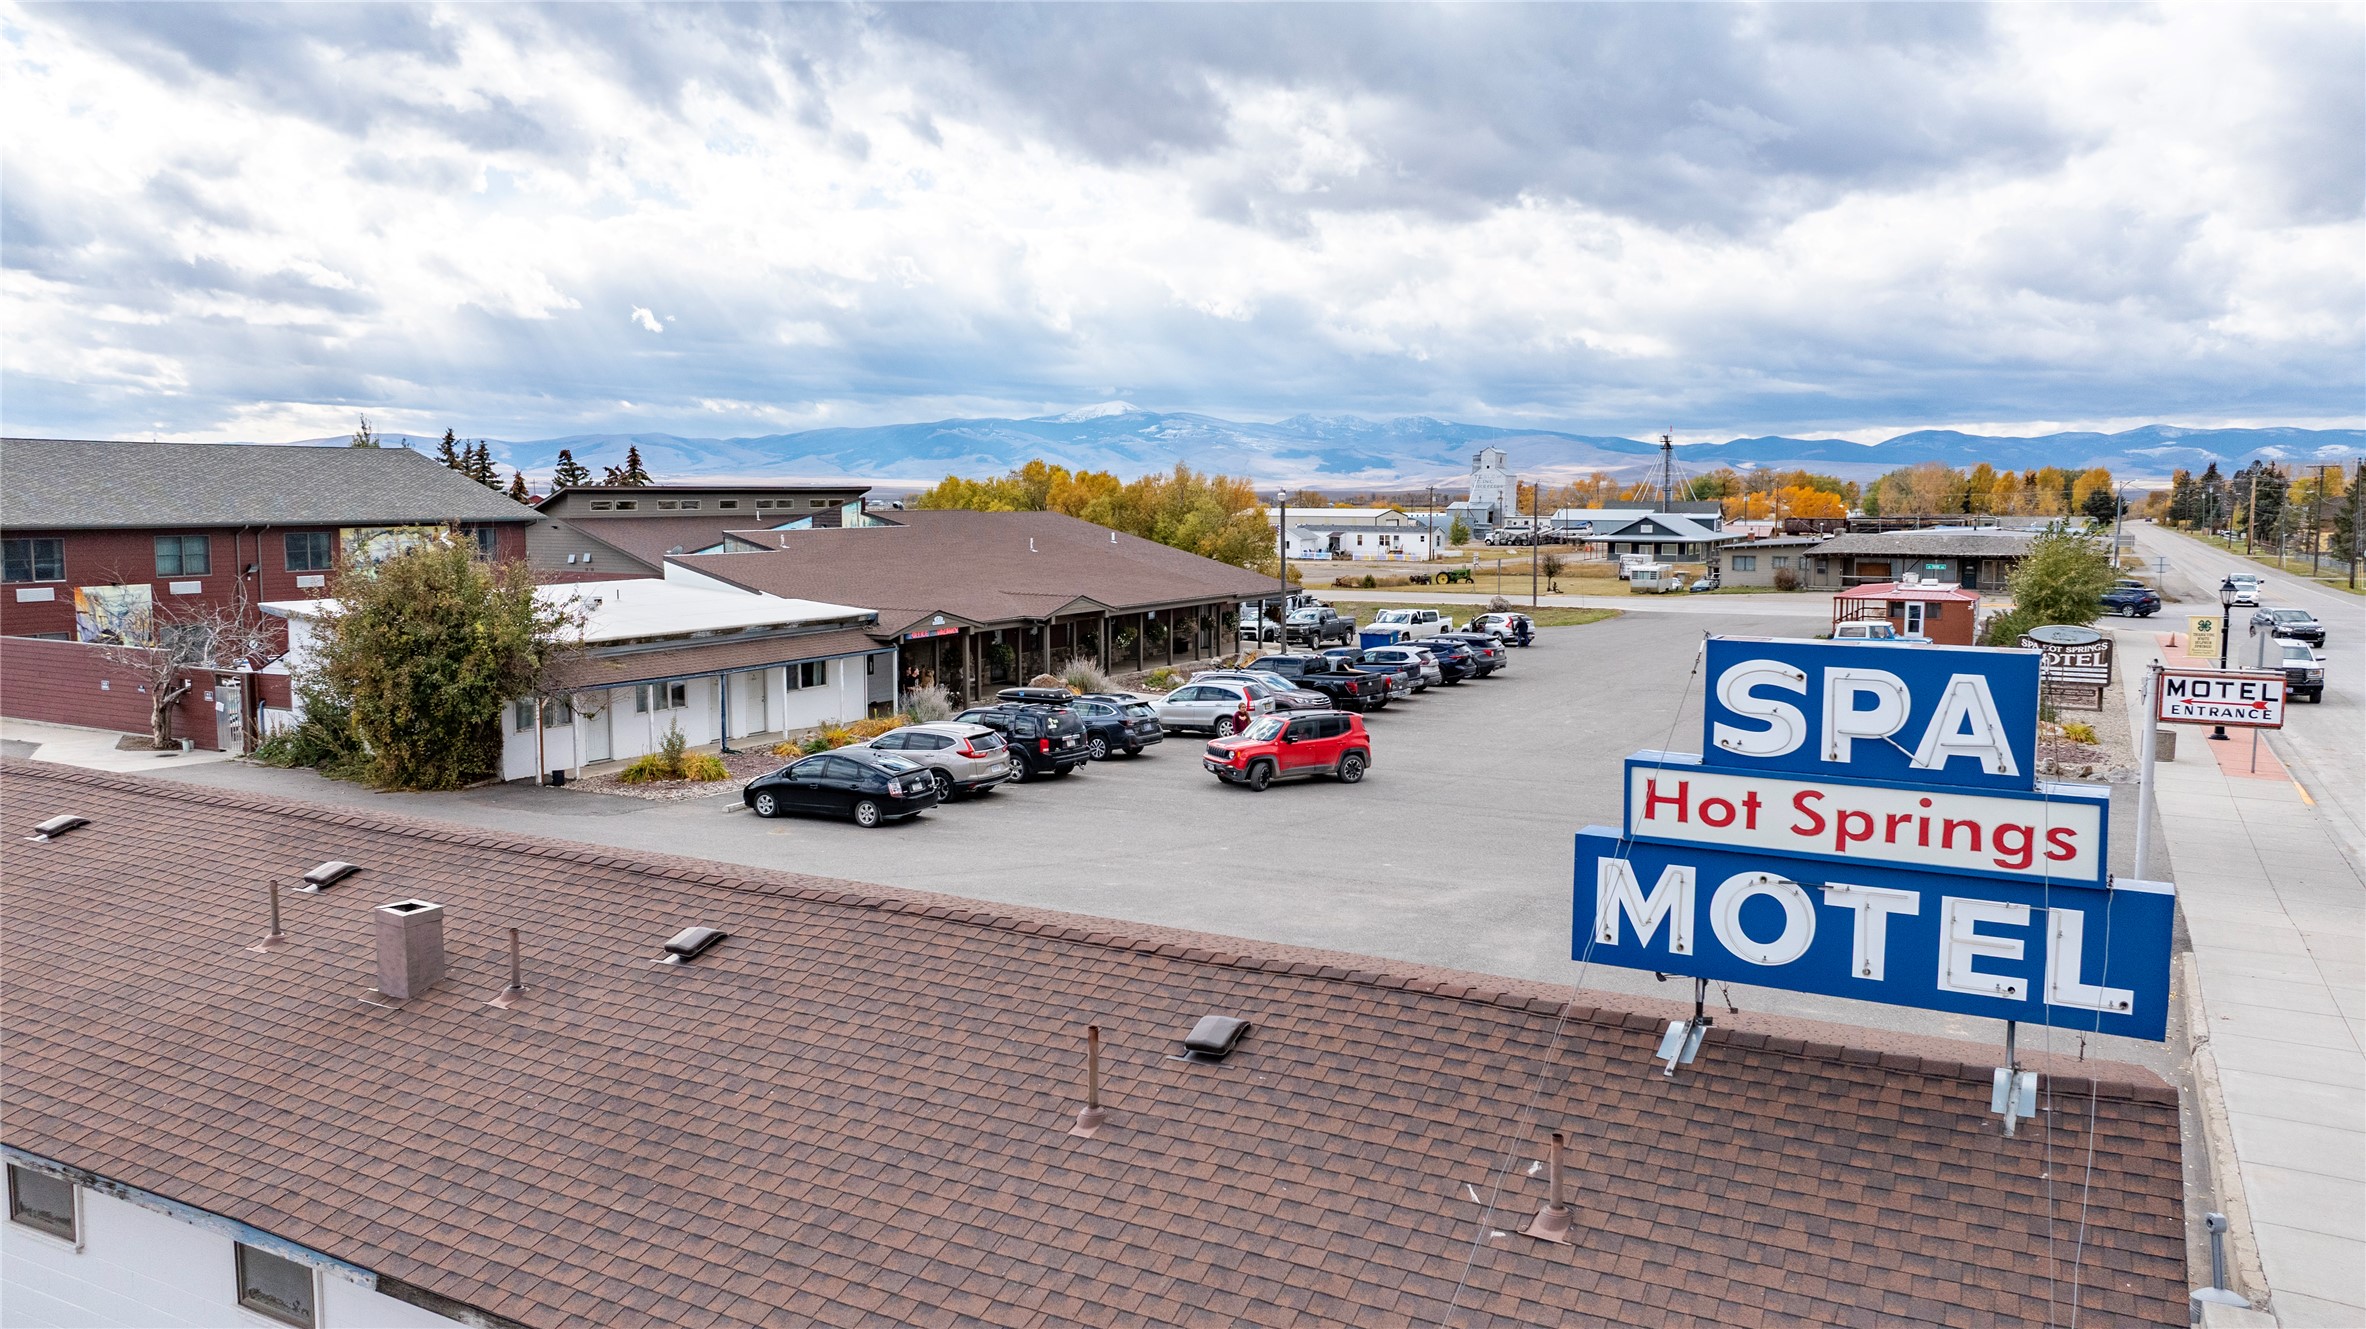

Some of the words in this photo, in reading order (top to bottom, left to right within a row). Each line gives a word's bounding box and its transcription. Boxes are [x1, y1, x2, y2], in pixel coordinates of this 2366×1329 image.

[2021, 639, 2039, 649] SPA
[2065, 642, 2109, 653] SPRINGS
[2042, 653, 2108, 667] OTEL
[2167, 679, 2279, 702] MOTEL
[1712, 659, 2020, 778] SPA
[2171, 705, 2273, 720] ENTRANCE
[1643, 778, 1763, 831] Hot
[1789, 789, 2078, 871] Springs
[1596, 856, 2135, 1016] MOTEL
